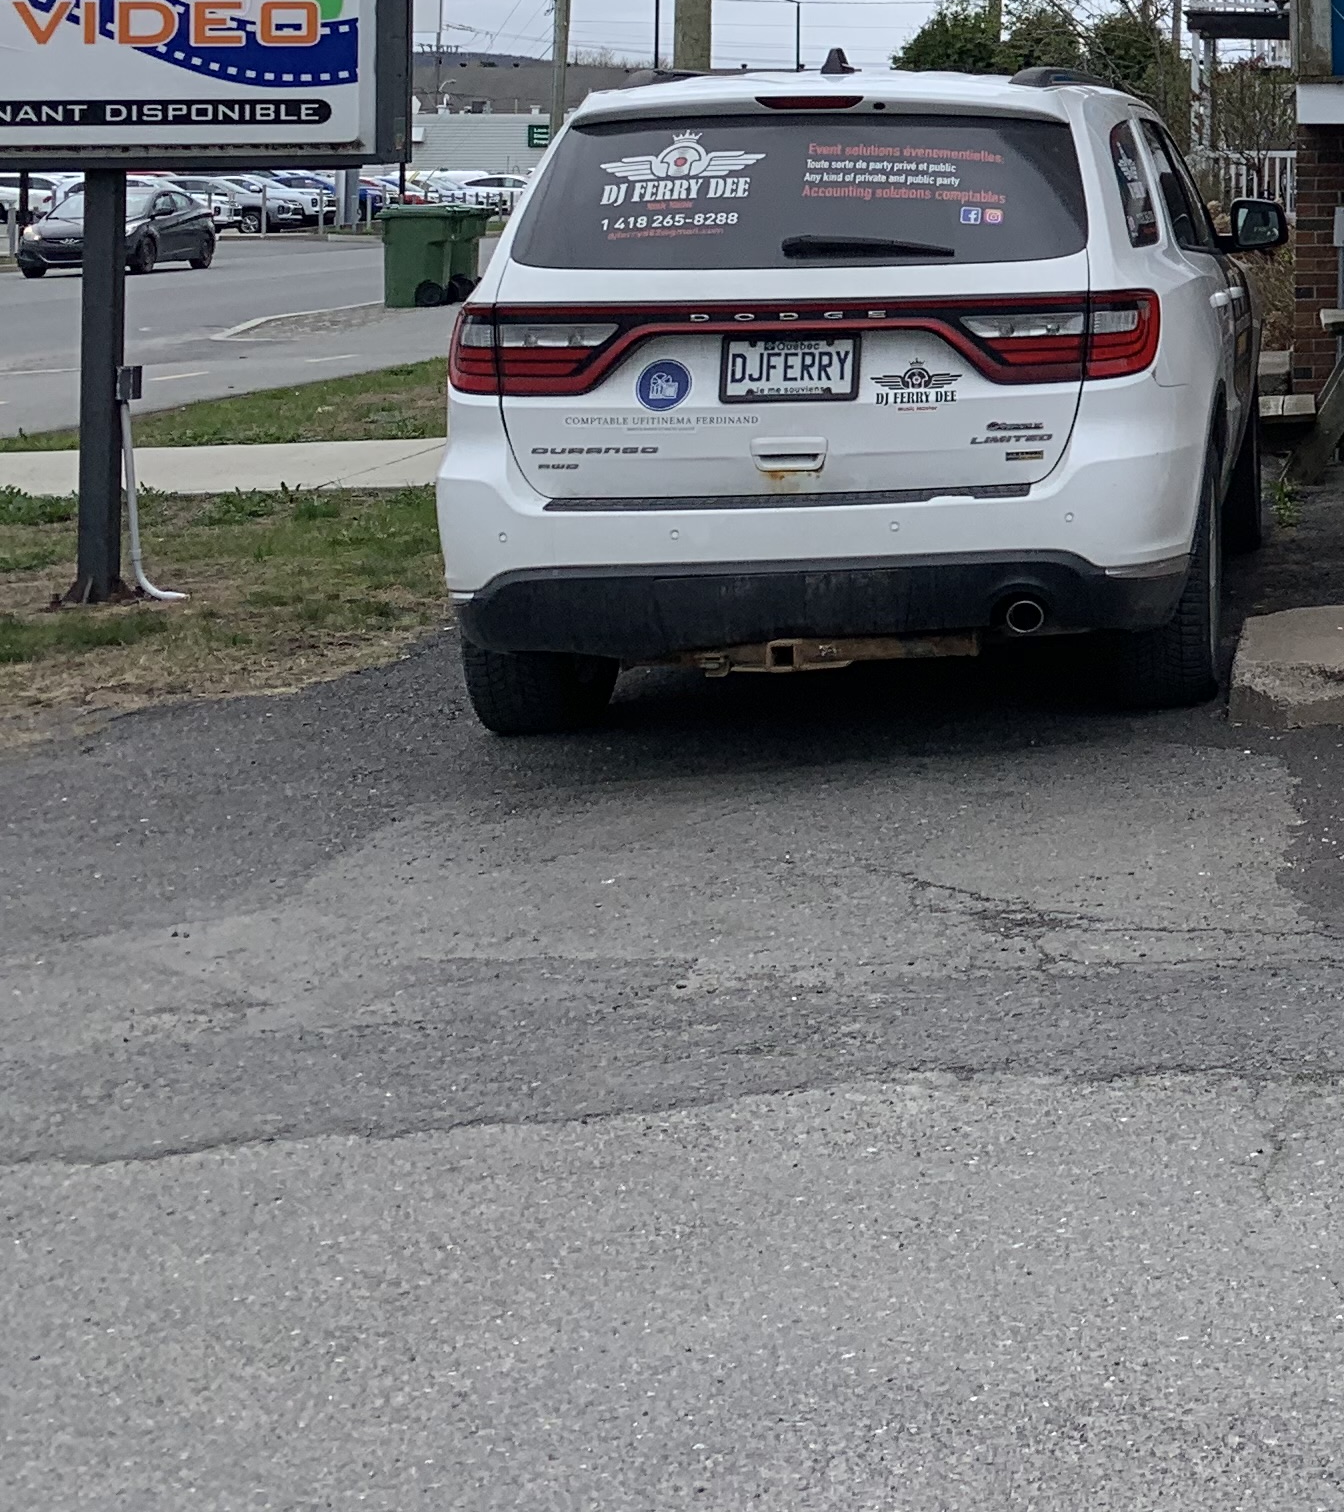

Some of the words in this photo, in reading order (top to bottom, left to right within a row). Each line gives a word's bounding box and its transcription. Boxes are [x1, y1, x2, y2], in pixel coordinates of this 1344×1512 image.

[105, 104, 320, 122] DISPONIBLE
[808, 143, 842, 155] Event
[845, 144, 900, 157] solutions
[806, 159, 829, 169] Toute
[831, 161, 854, 169] sorte
[856, 160, 867, 169] de
[869, 161, 893, 172] party
[918, 163, 928, 171] et
[929, 163, 957, 173] public
[804, 173, 822, 183] Any
[823, 172, 843, 182] kind
[845, 172, 854, 182] of
[856, 173, 886, 184] private
[889, 174, 906, 184] and
[907, 174, 935, 185] public
[936, 176, 960, 187] party
[600, 183, 628, 207] DJ
[631, 178, 704, 202] FERRY
[707, 177, 750, 198] DEE
[801, 185, 872, 201] Accounting
[875, 186, 931, 199] solutions
[935, 189, 1006, 204] comptables
[601, 219, 609, 231] 1
[614, 216, 647, 229] 418
[651, 212, 739, 228] 265-8288
[690, 310, 887, 323] DODGE
[730, 350, 851, 384] DJFERRY
[784, 386, 824, 394] souviens
[876, 393, 889, 406] DJ
[893, 391, 931, 404] FERRY
[935, 390, 957, 402] DEE
[565, 416, 629, 426] COMPTABLE
[696, 415, 759, 425] FERDINAND
[970, 433, 1053, 445] LIMITED
[531, 445, 660, 455] DURANGO
